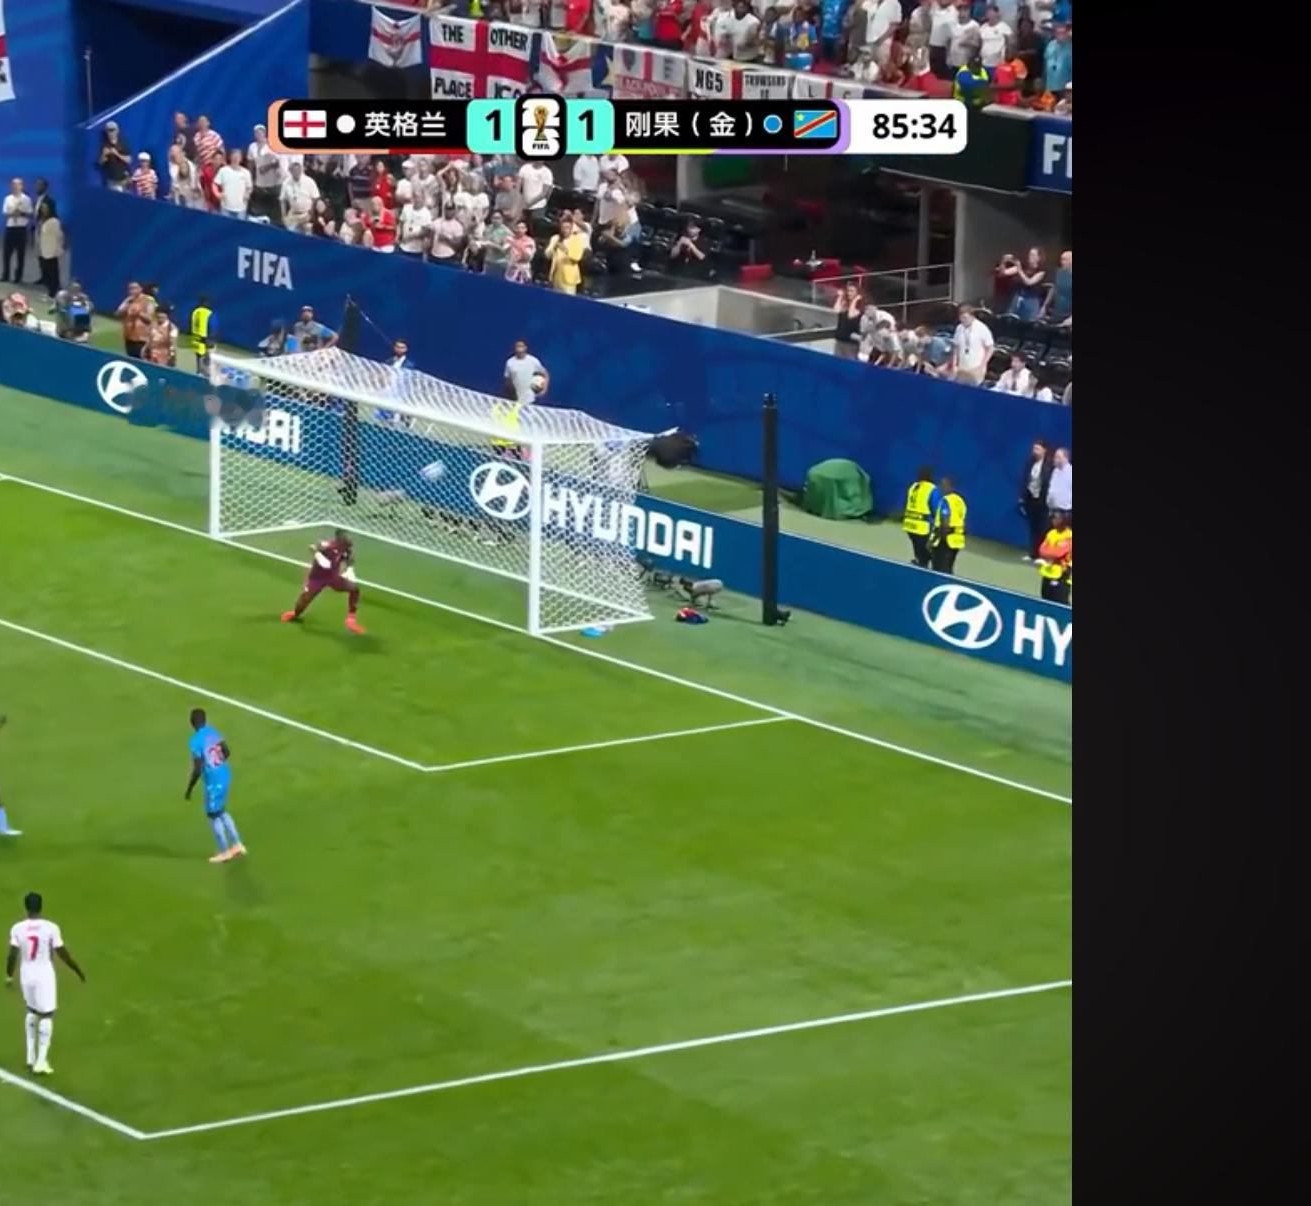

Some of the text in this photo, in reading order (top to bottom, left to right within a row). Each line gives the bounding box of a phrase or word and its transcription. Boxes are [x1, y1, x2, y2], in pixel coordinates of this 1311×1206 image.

[441, 24, 529, 50] THE OTHER
[434, 77, 472, 98] PLACE
[695, 68, 723, 93] NG5
[238, 246, 294, 290] FIFA
[543, 484, 714, 568] HYUNDAI
[27, 935, 39, 961] 7
